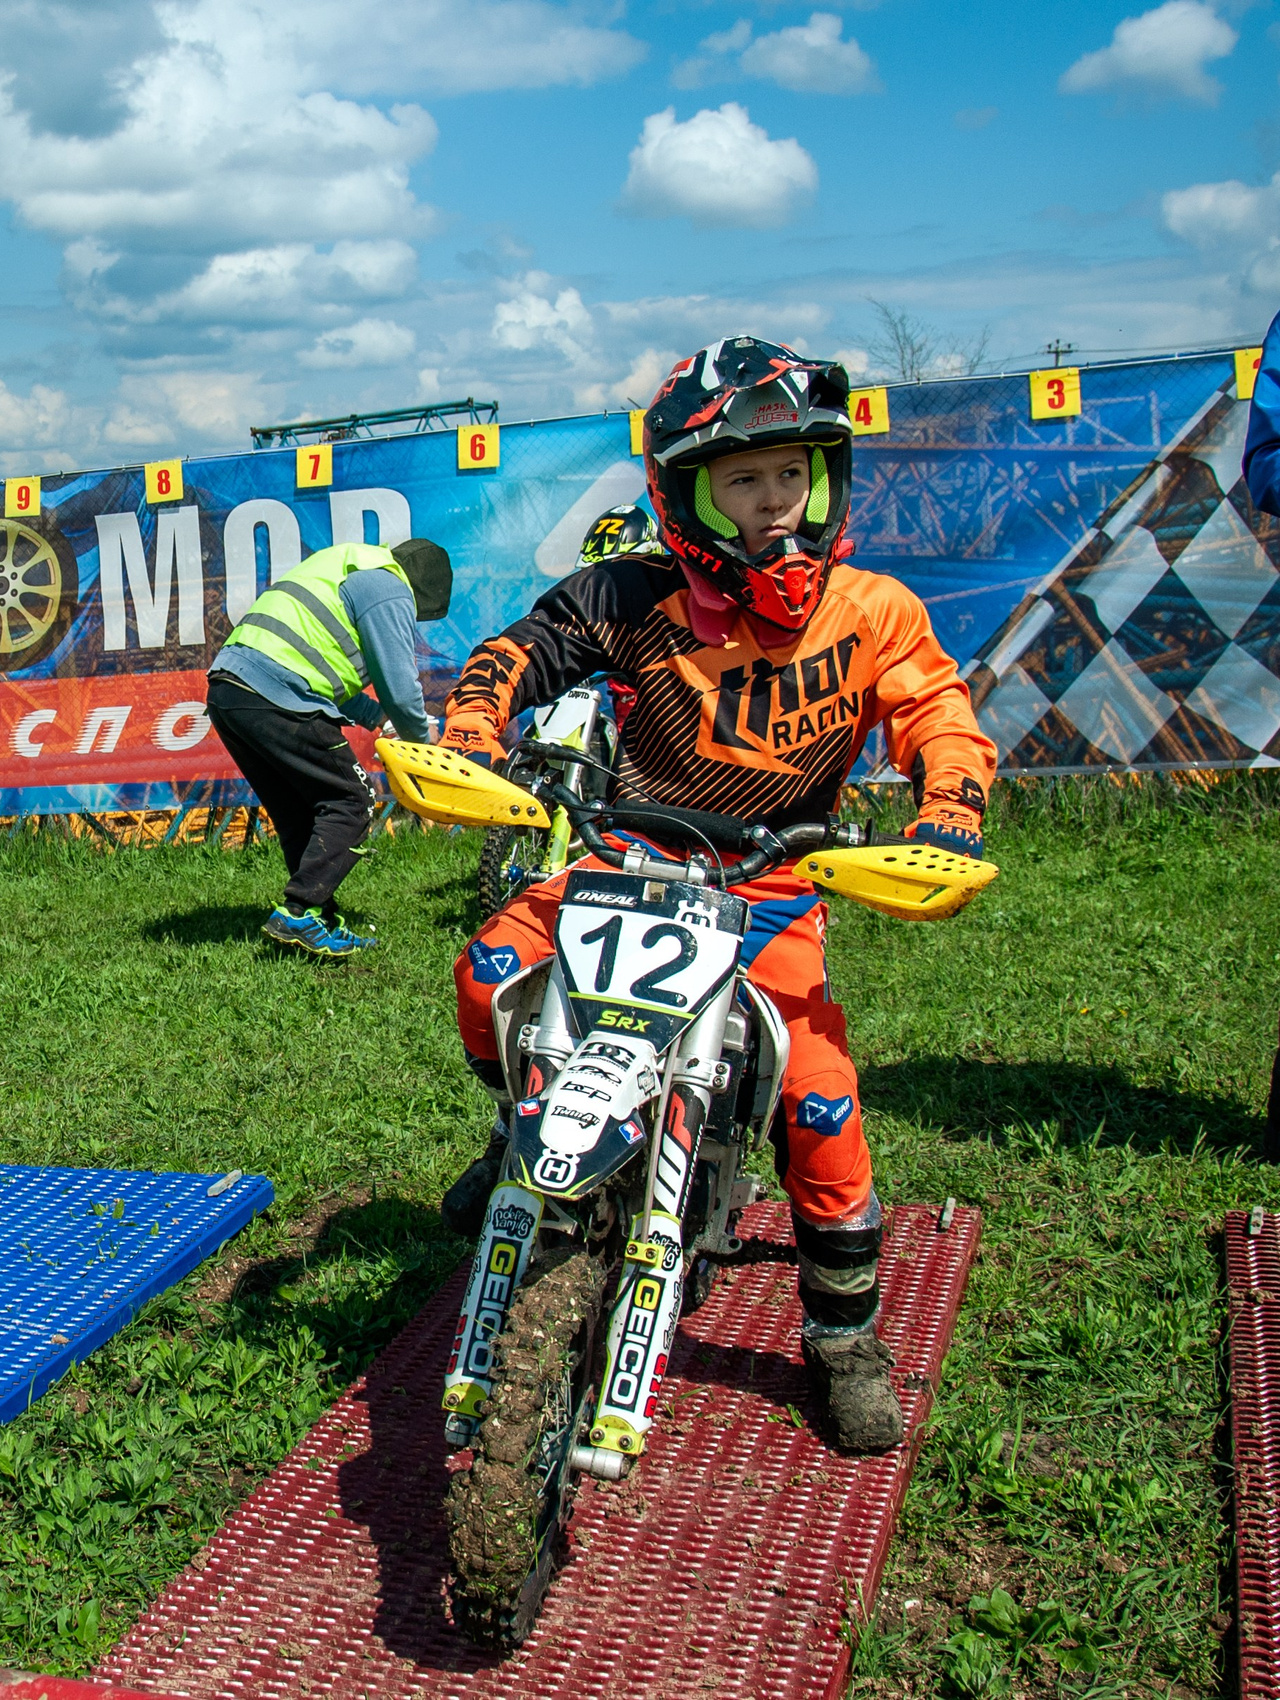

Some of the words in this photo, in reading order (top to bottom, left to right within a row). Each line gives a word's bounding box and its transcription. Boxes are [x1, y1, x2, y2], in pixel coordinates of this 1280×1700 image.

[1046, 379, 1065, 410] 3
[854, 397, 873, 426] 4
[470, 433, 486, 461] 6
[309, 454, 321, 480] 7
[157, 469, 171, 495] 8
[17, 485, 30, 511] 9
[594, 518, 625, 535] 72
[580, 914, 698, 1008] 12
[595, 1009, 654, 1033] SRX
[831, 1097, 851, 1122] LEATT
[468, 1242, 517, 1375] GEICO
[610, 1278, 662, 1405] GEICO
